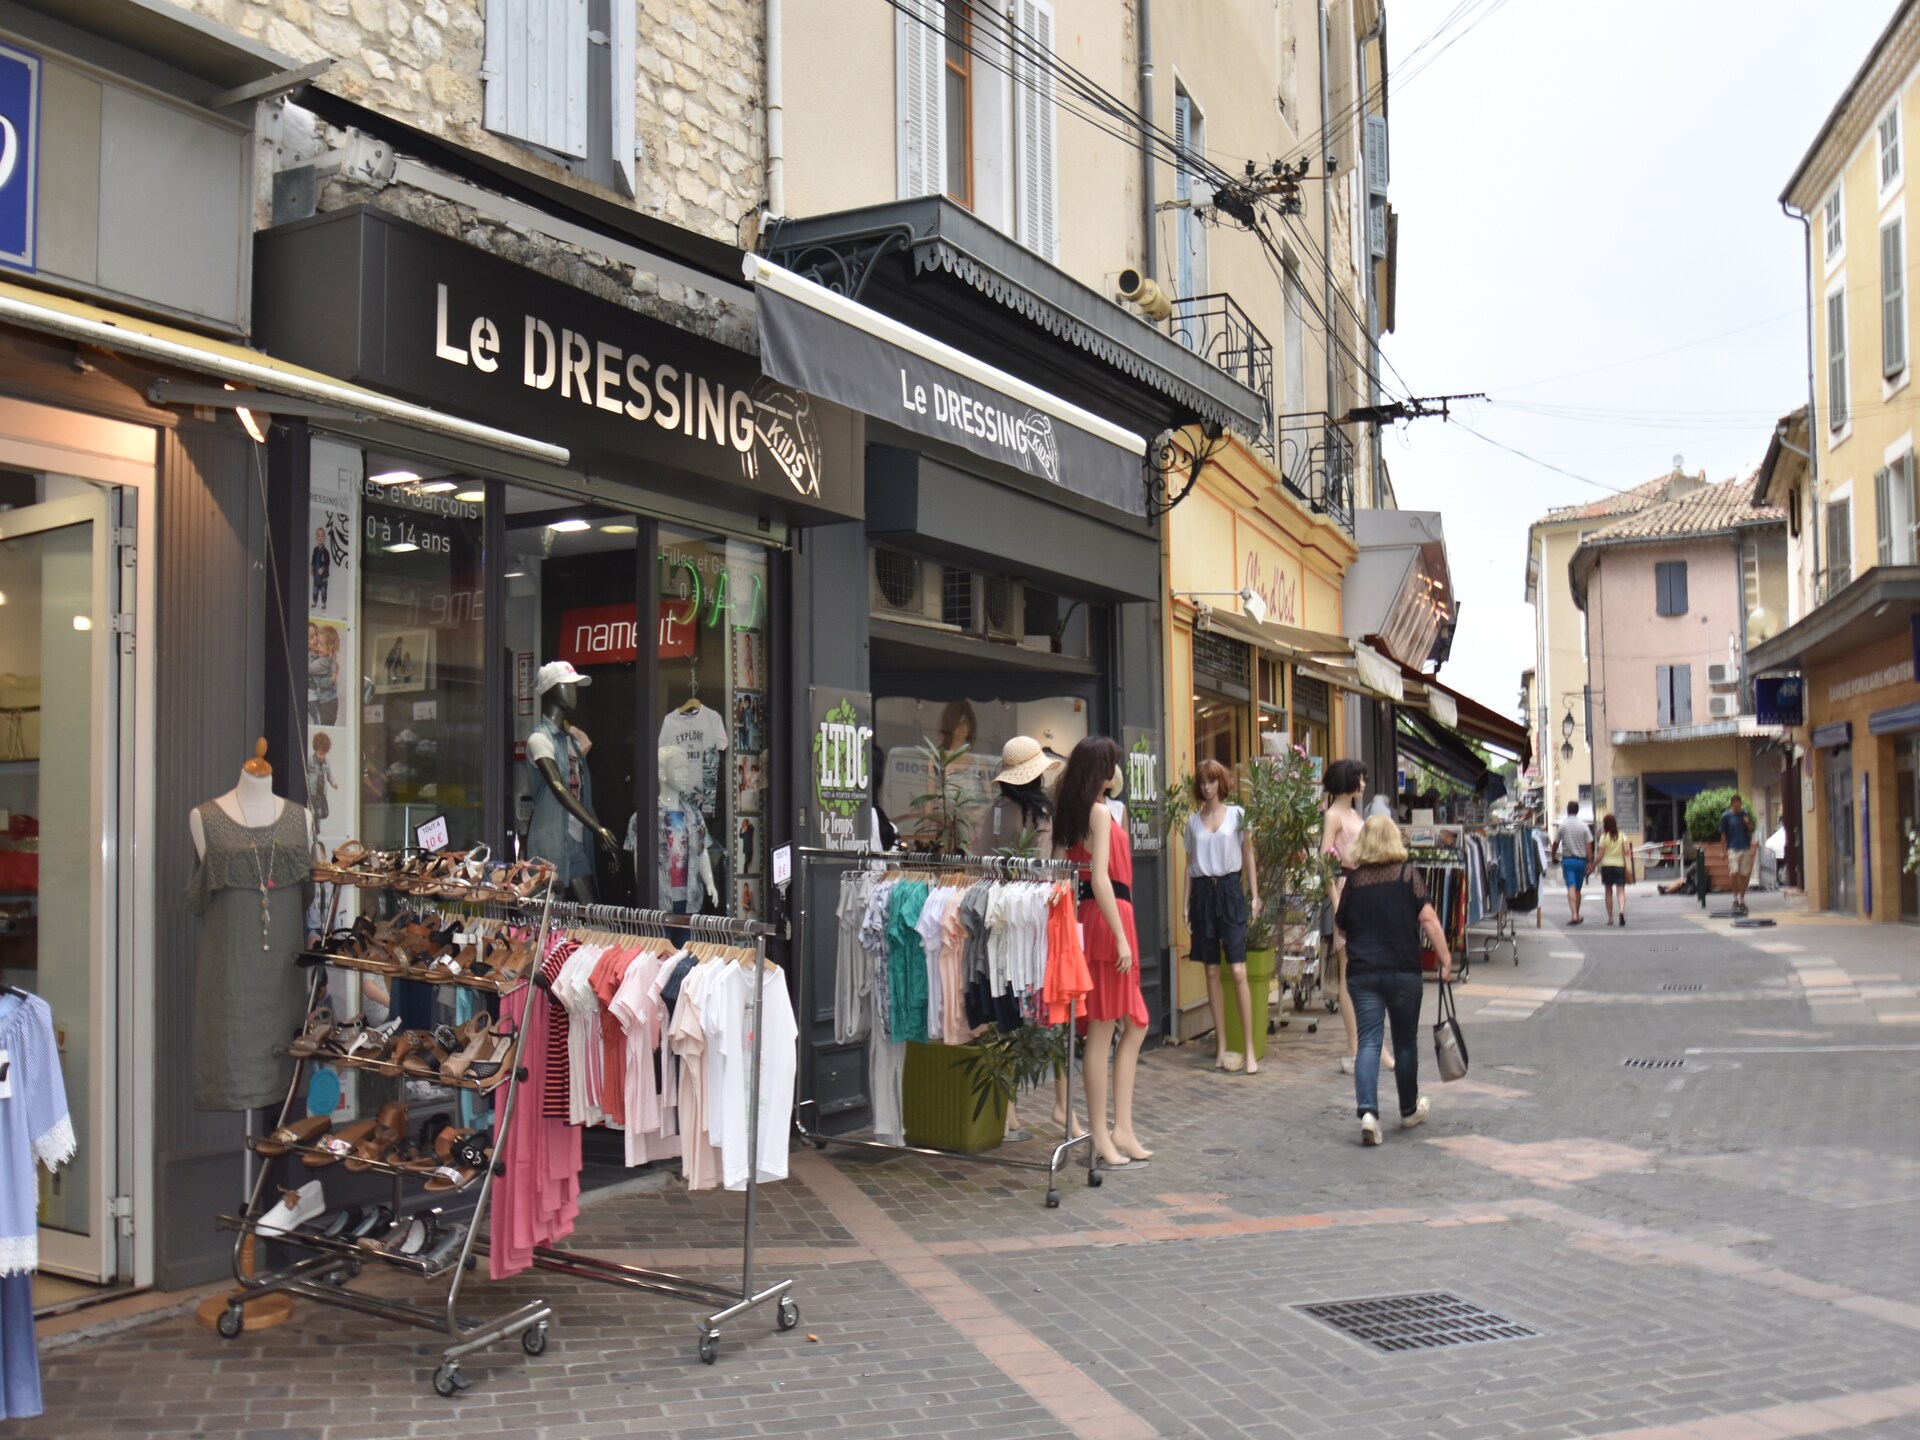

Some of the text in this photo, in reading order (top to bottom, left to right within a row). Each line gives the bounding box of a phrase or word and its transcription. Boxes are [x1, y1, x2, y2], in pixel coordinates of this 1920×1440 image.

[436, 283, 755, 453] Le DRESSING
[901, 369, 1028, 453] Le DRESSING
[398, 521, 417, 546] 14
[421, 532, 451, 553] ans
[662, 545, 694, 569] Filles
[575, 622, 637, 653] name
[676, 730, 704, 744] EXPLORE
[820, 722, 868, 789] LTDC
[1130, 752, 1156, 801] LTDC
[820, 811, 854, 838] Le Temps
[825, 833, 869, 856] Des Couleurs
